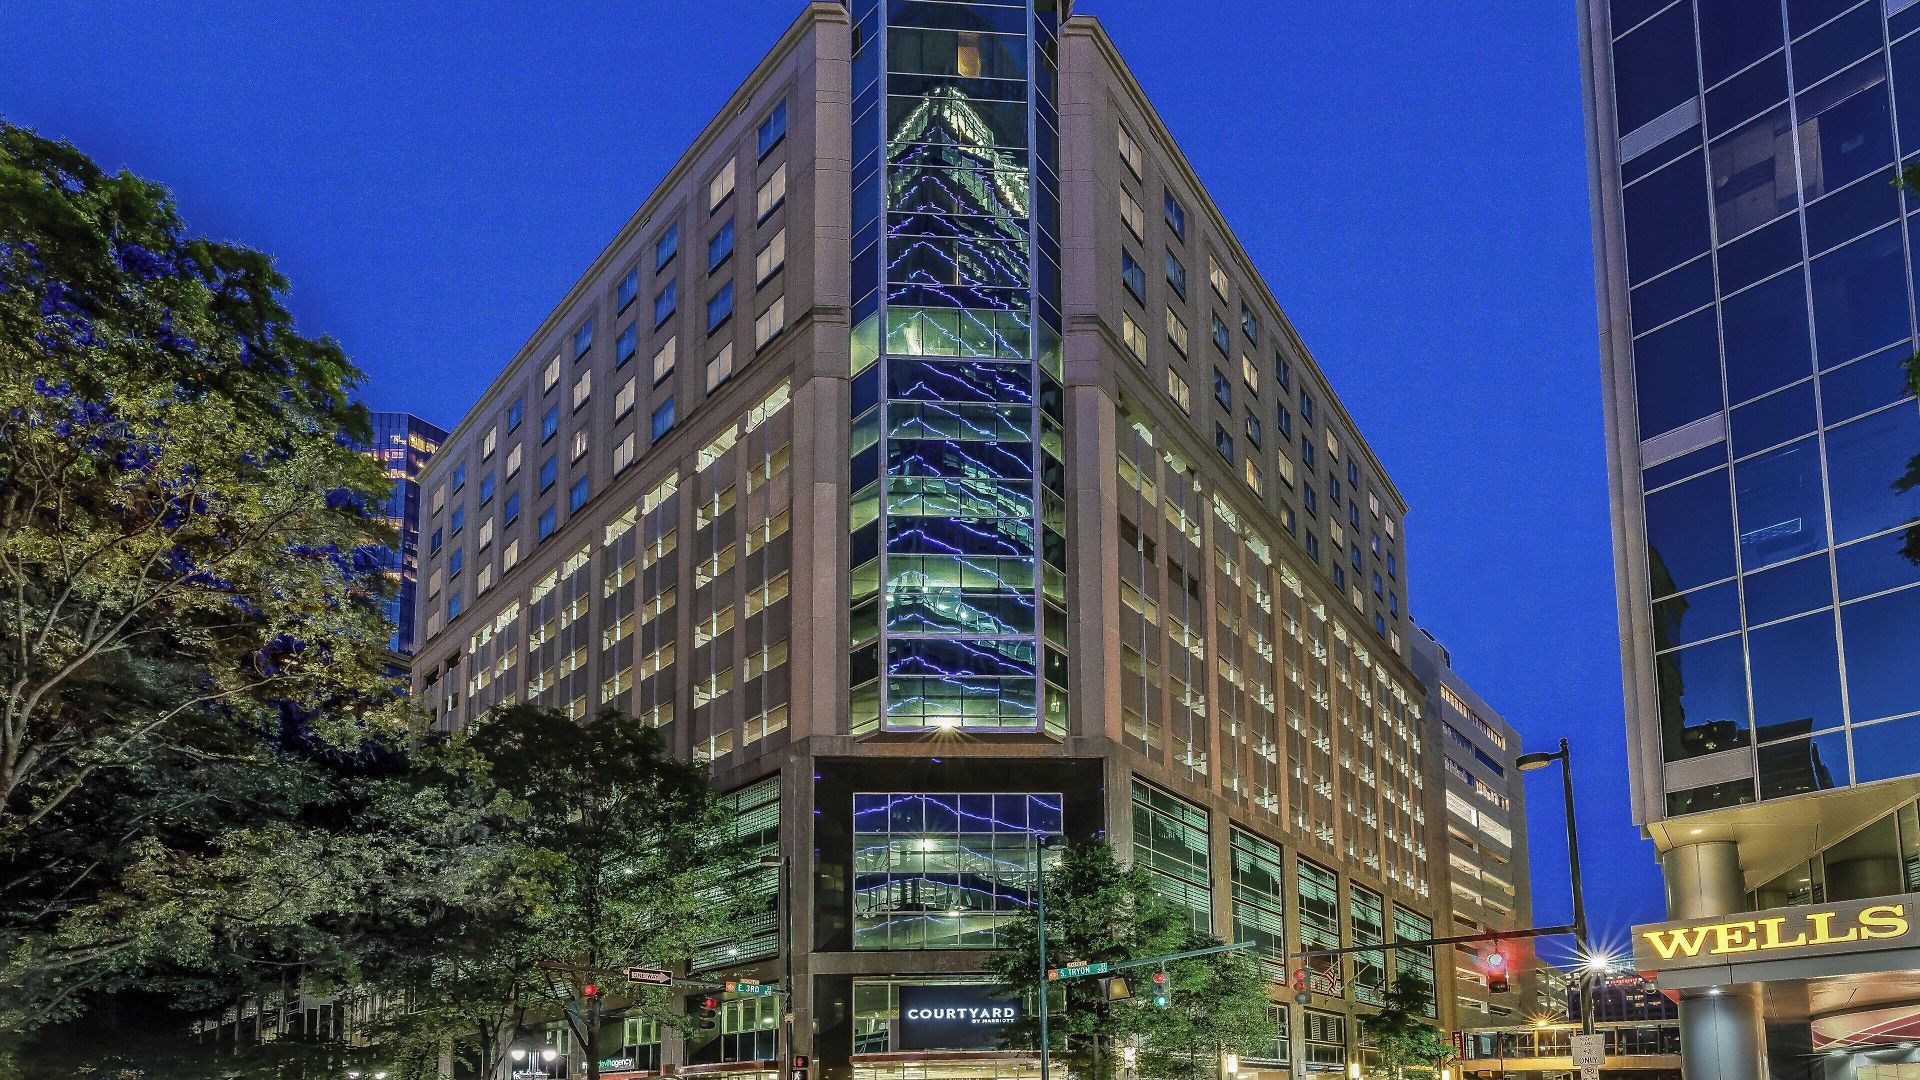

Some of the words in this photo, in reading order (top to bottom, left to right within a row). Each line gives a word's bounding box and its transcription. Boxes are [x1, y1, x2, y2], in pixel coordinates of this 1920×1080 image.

[1643, 904, 1909, 960] WELLS
[632, 971, 645, 979] ONE
[1068, 966, 1090, 976] TRYON
[745, 985, 760, 993] 3RD
[907, 1007, 1015, 1020] COURTYARD
[1579, 1056, 1598, 1064] ONLY
